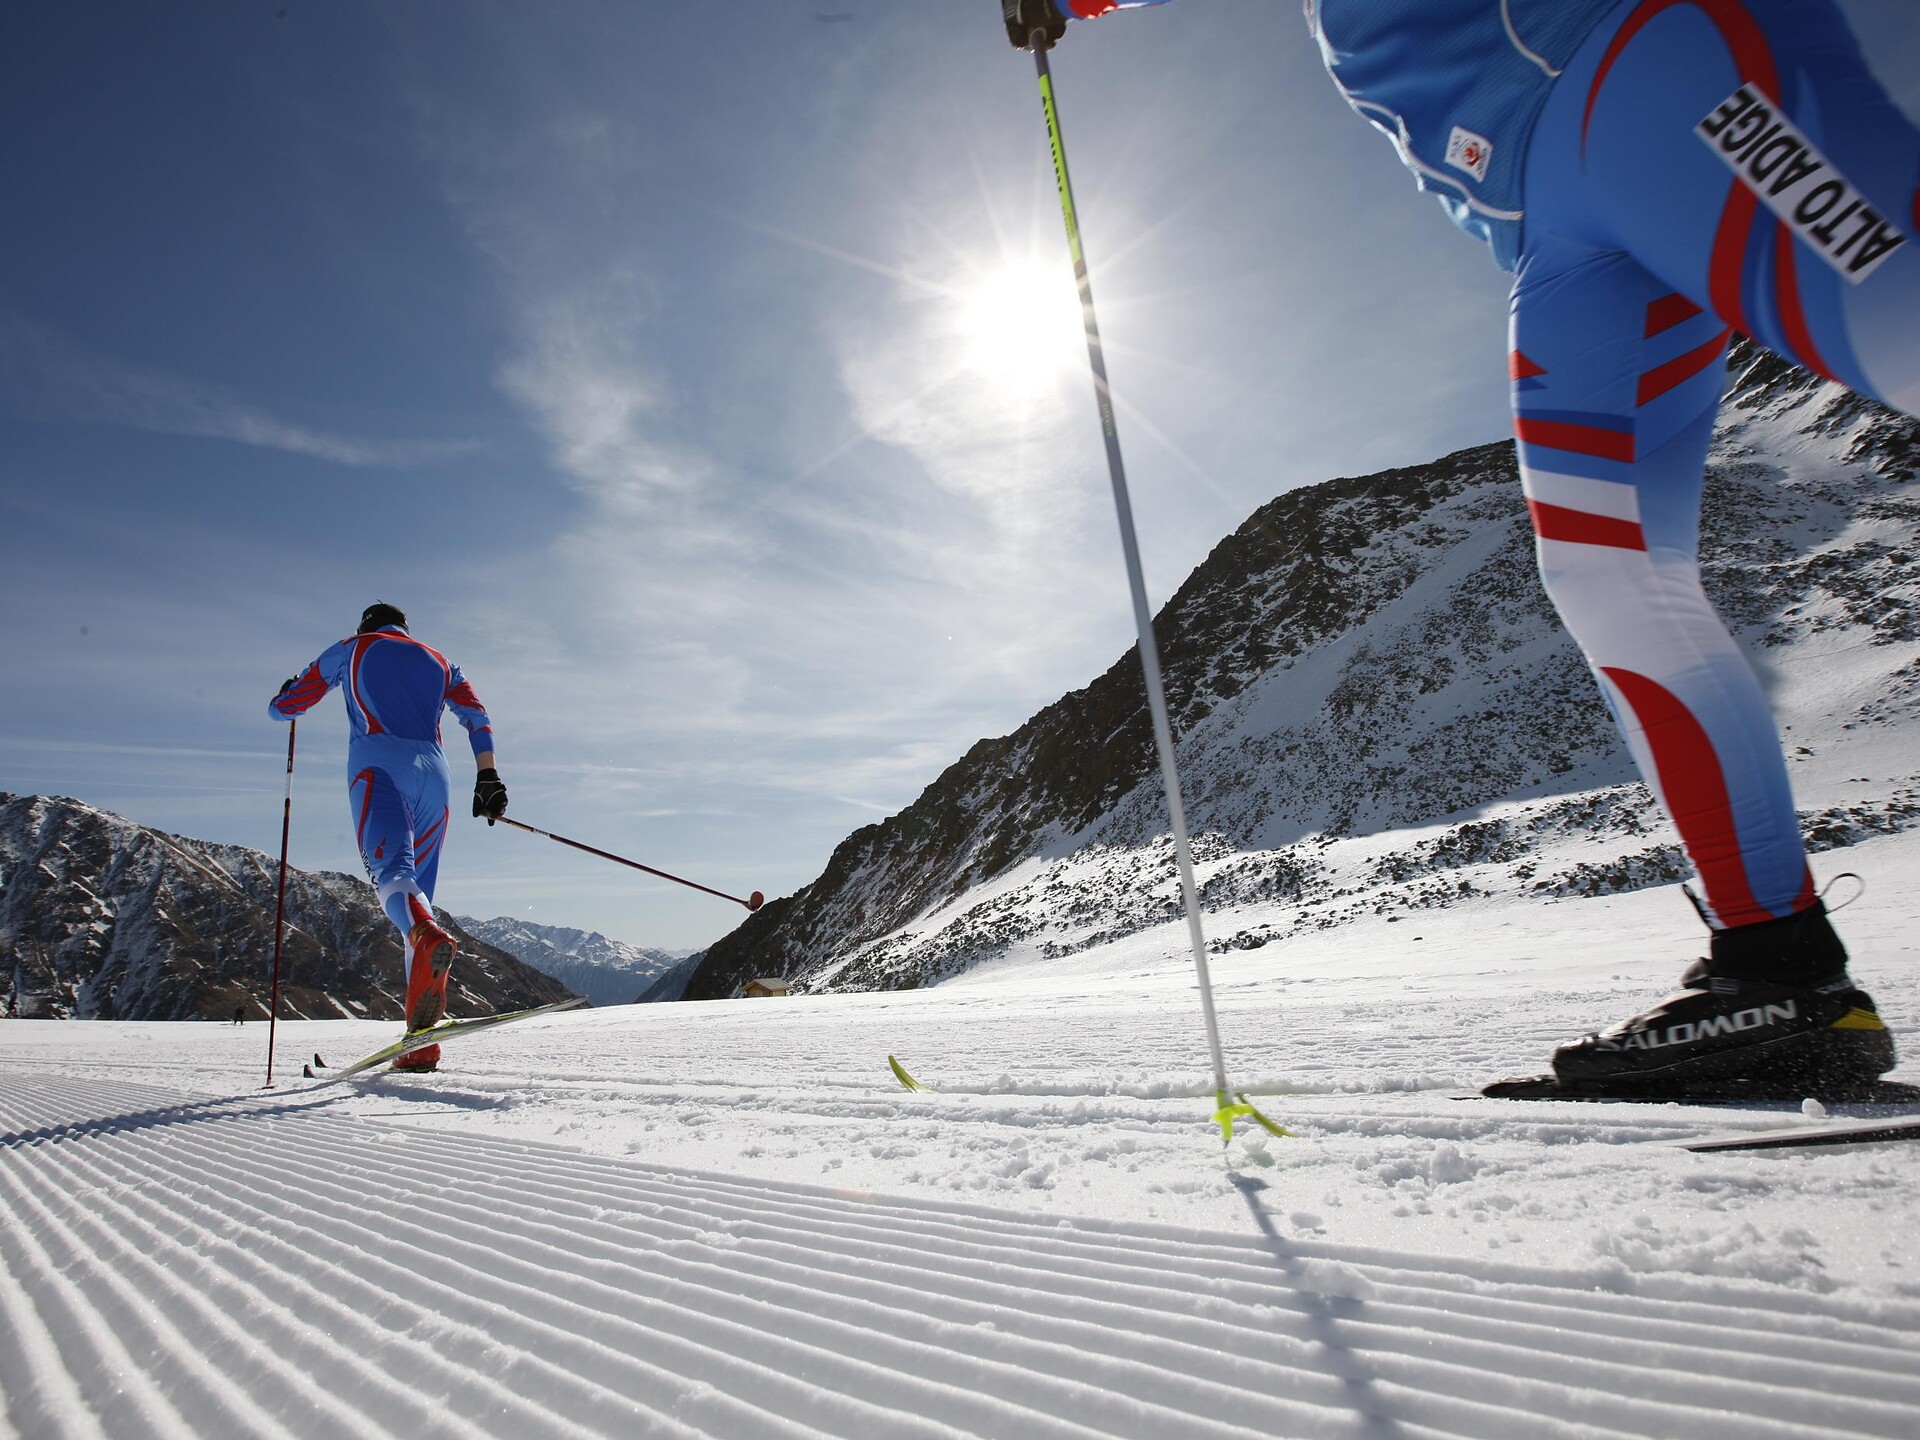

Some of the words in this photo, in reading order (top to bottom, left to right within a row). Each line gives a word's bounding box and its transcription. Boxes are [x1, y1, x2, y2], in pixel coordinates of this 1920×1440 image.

[1701, 88, 1823, 197] ADIGE
[1794, 179, 1907, 273] ALTO
[1596, 1000, 1798, 1051] SALOMON
